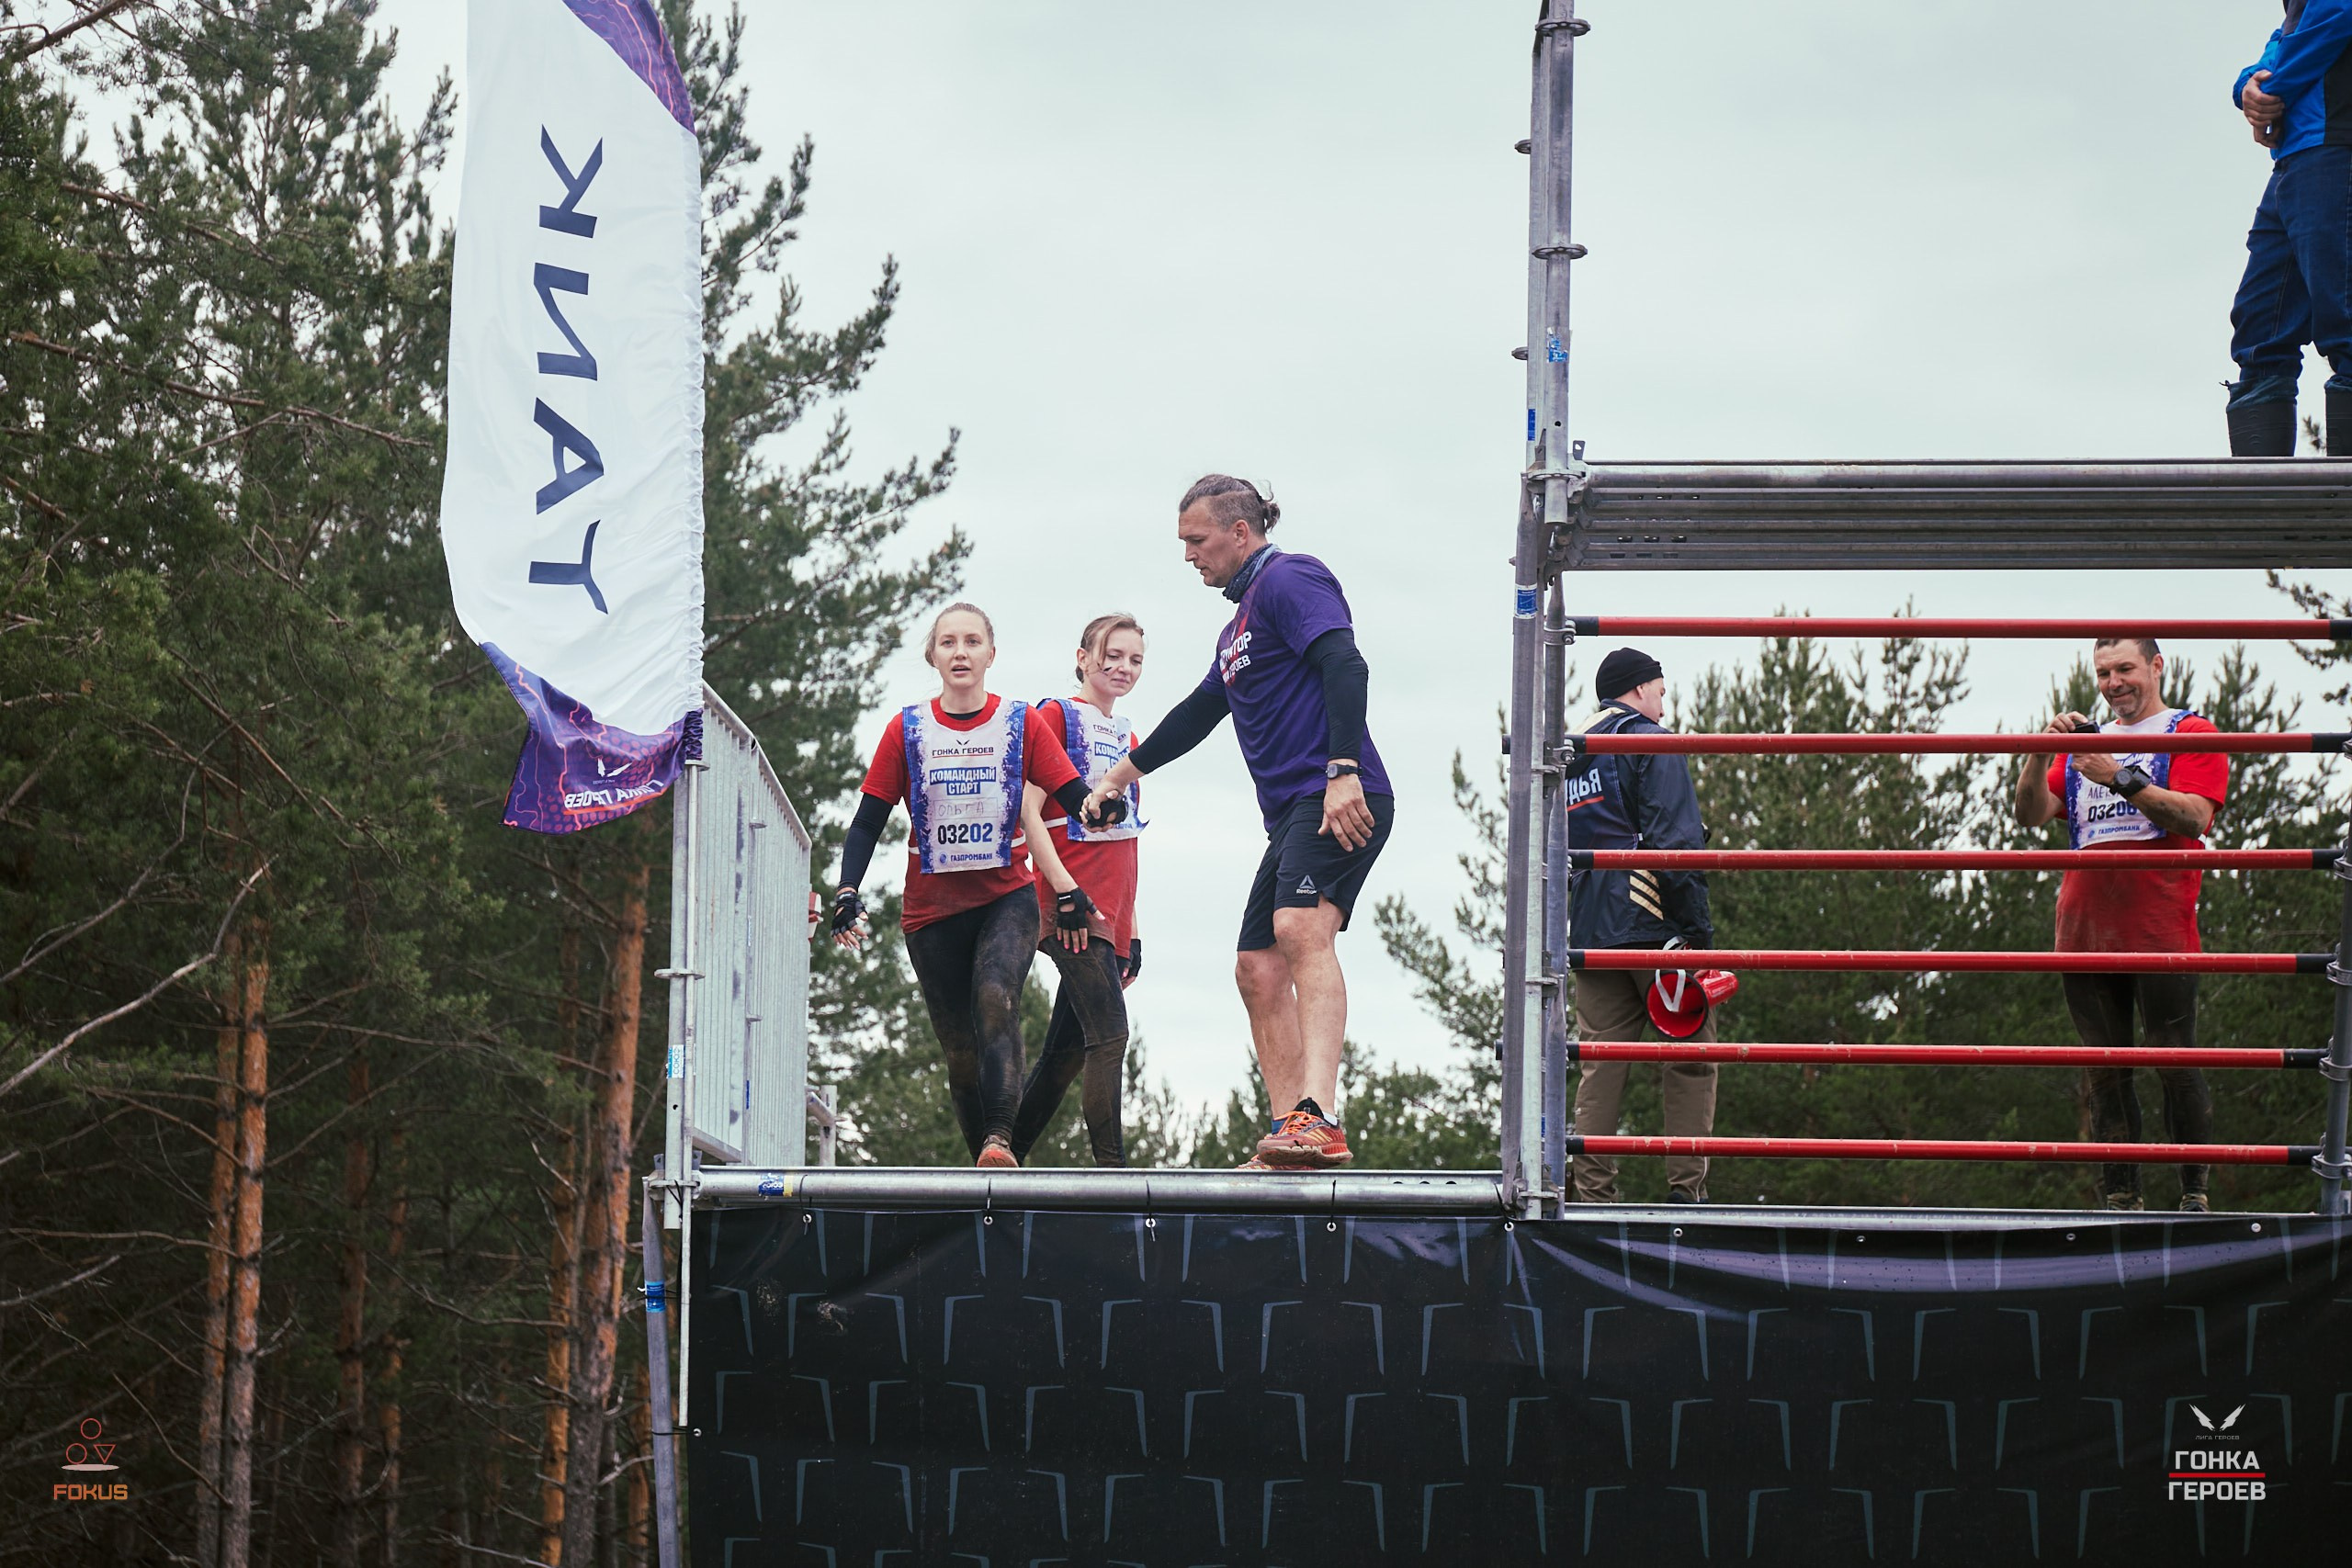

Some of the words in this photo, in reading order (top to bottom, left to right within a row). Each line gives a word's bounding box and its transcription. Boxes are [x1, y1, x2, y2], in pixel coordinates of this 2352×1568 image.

[932, 748, 960, 757] ГОНКА
[962, 746, 994, 754] ГЕРОЕВ
[930, 766, 996, 784] КОМАНДНЫЙ
[948, 783, 978, 795] СТАРТ
[1565, 768, 1602, 807] ДЬЯ
[937, 823, 993, 844] 03202
[2098, 825, 2141, 834] ГАЗПРОМБАНК
